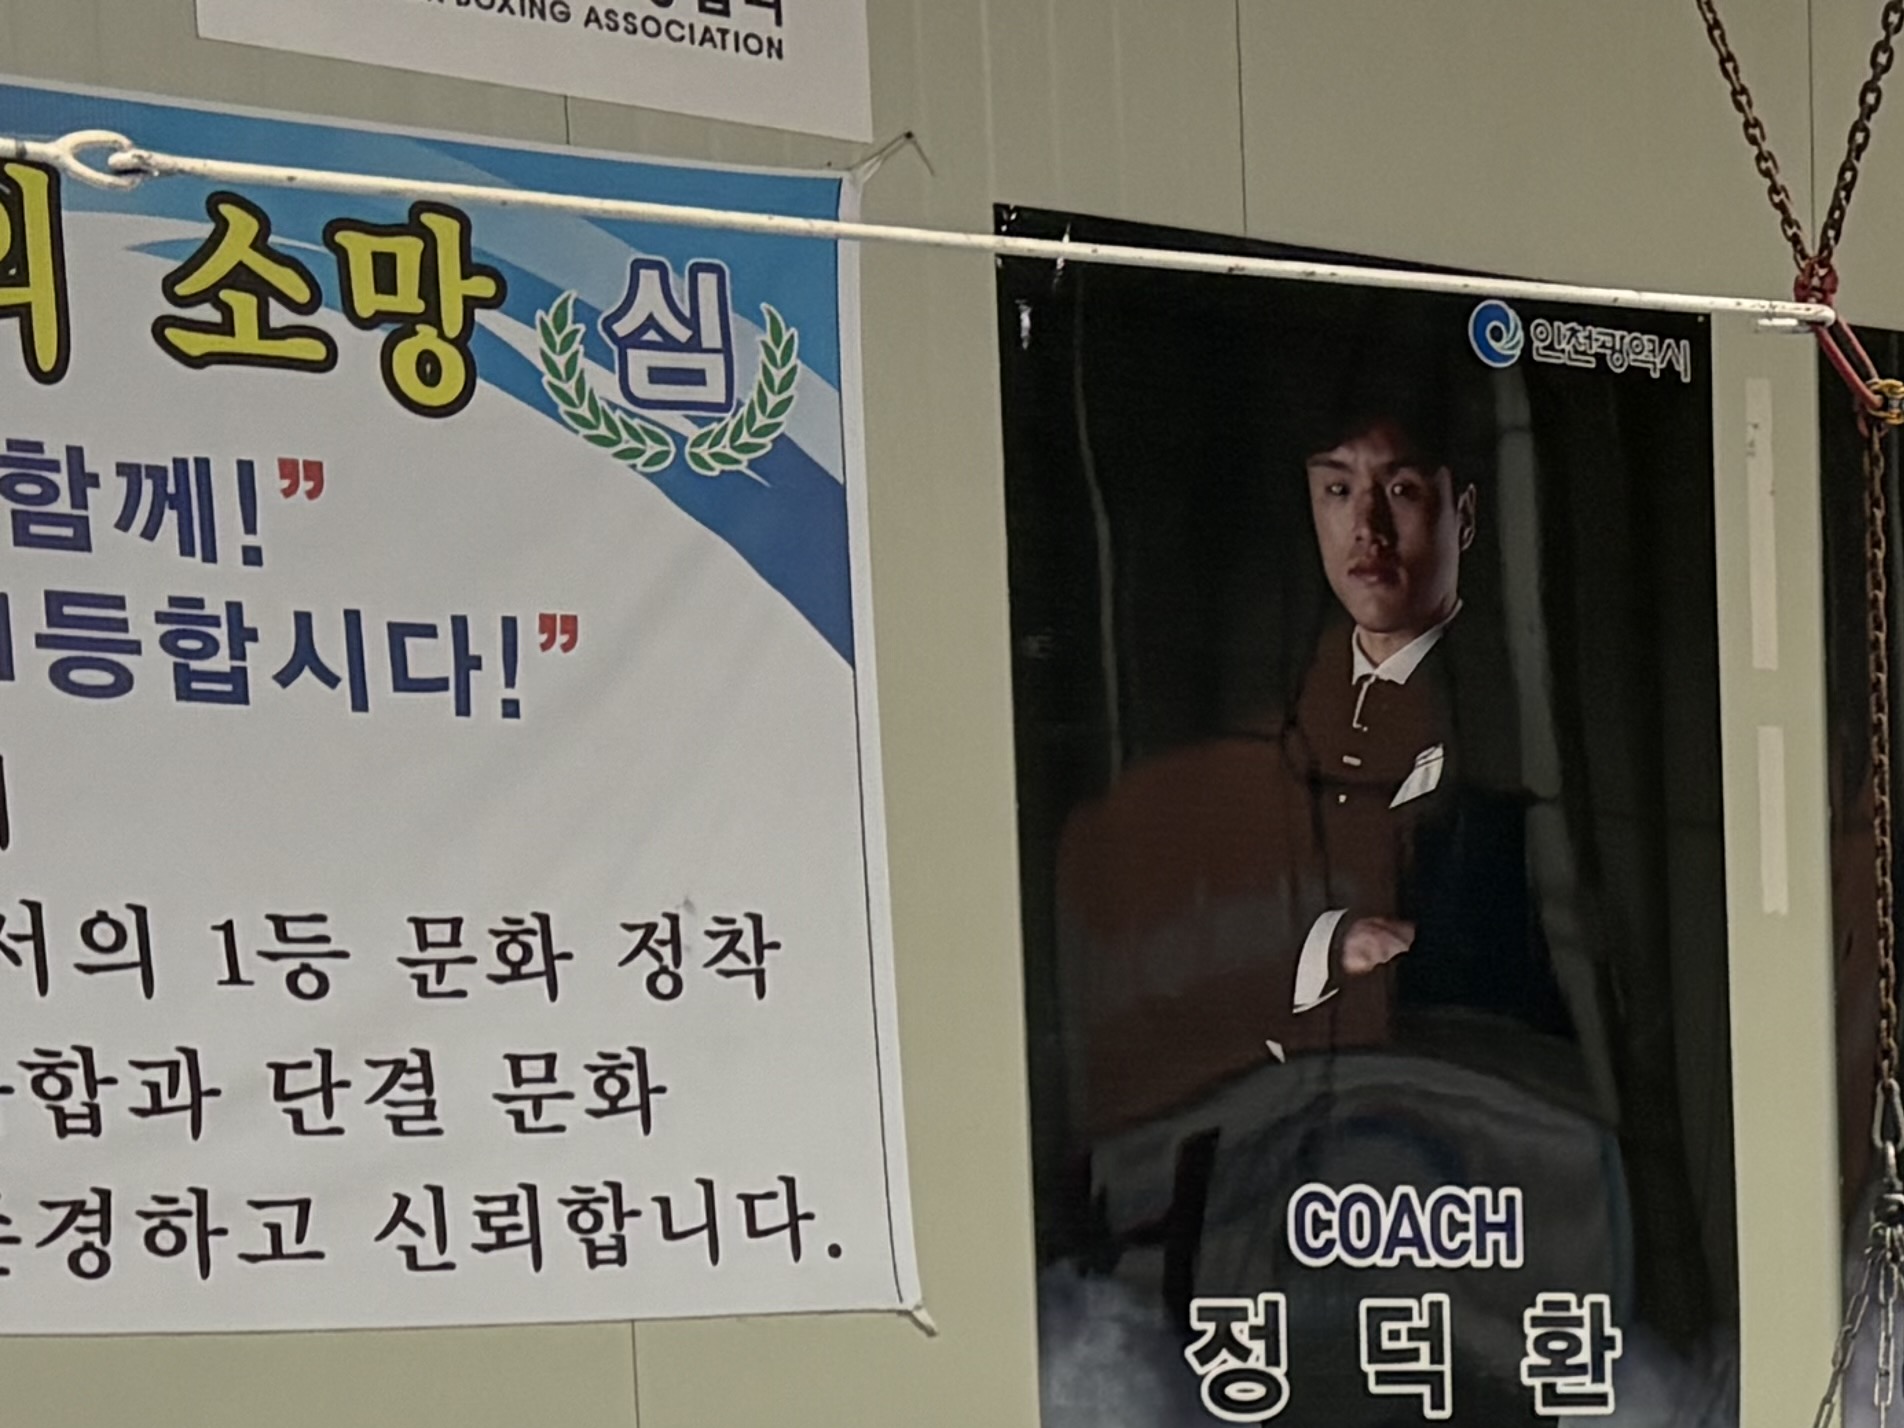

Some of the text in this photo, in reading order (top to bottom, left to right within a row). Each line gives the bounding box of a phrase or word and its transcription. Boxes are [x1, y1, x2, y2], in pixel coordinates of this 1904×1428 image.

[583, 5, 784, 60] ASSOCIATION
[152, 190, 508, 418] 소망
[601, 256, 738, 416] 심
[1530, 318, 1692, 383] 인천광역시
[0, 589, 579, 720] 등합시다!”
[210, 912, 352, 1002] 1등
[396, 911, 575, 1003] 문화
[617, 910, 783, 1002] 정착
[0, 1044, 669, 1142] 합과 단결 문화
[0, 1175, 845, 1282] 경하고 신뢰합니다.
[1287, 1183, 1524, 1268] COACH
